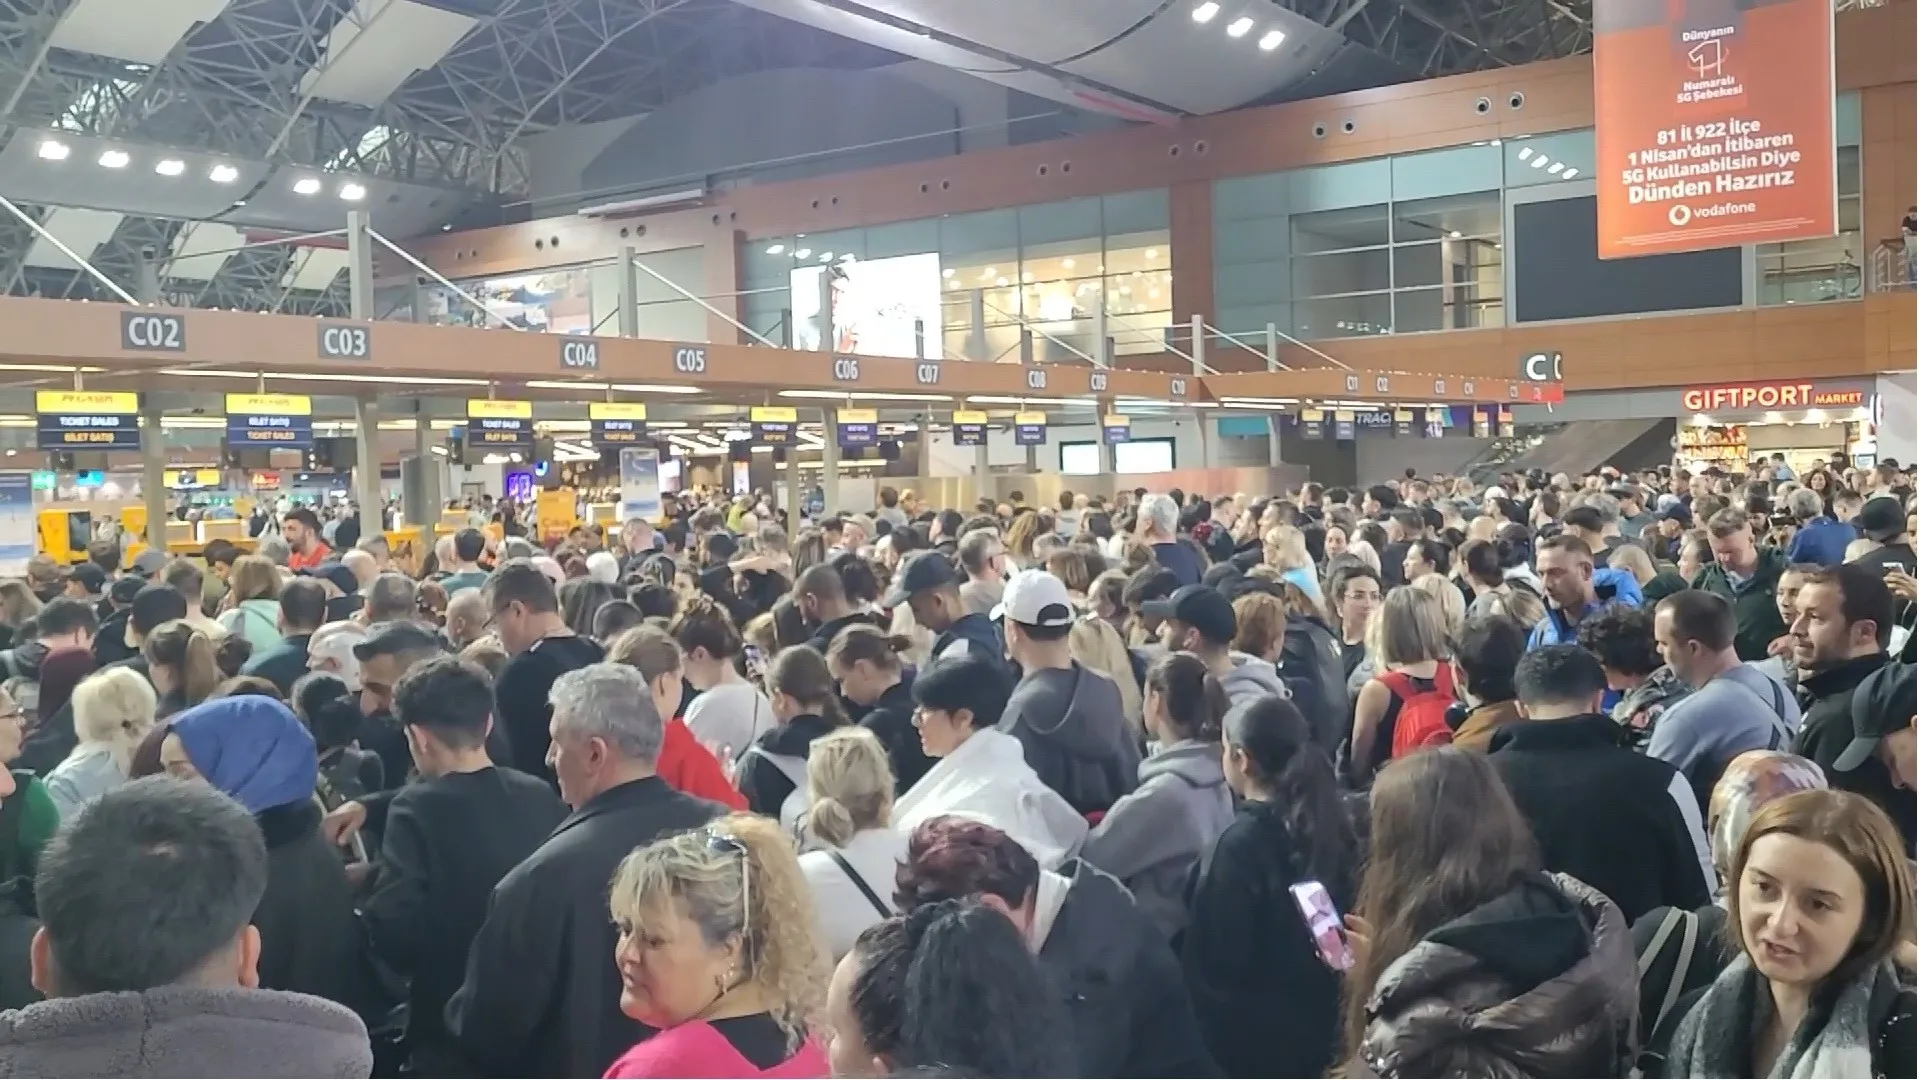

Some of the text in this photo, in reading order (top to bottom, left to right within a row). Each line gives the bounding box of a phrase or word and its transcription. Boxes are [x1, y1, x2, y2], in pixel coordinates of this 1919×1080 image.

[1682, 26, 1735, 41] Dünyanın
[1676, 84, 1743, 104] 5G Şebekesi
[1683, 75, 1735, 91] Numaralı
[1657, 128, 1676, 145] 81
[1695, 122, 1726, 140] 922
[1622, 150, 1801, 185] 5G Kullanabilsin Diye
[1628, 152, 1637, 166] 1
[1628, 170, 1795, 204] Dünden Hazırız
[1693, 202, 1756, 218] vodafone
[128, 316, 180, 348] C02
[323, 328, 366, 357] C03
[563, 342, 597, 367] C04
[676, 348, 705, 372] C05
[834, 359, 859, 380] C06
[917, 364, 939, 384] C07
[1526, 353, 1547, 380] C
[1683, 384, 1862, 411] GIFTPORT MARKET
